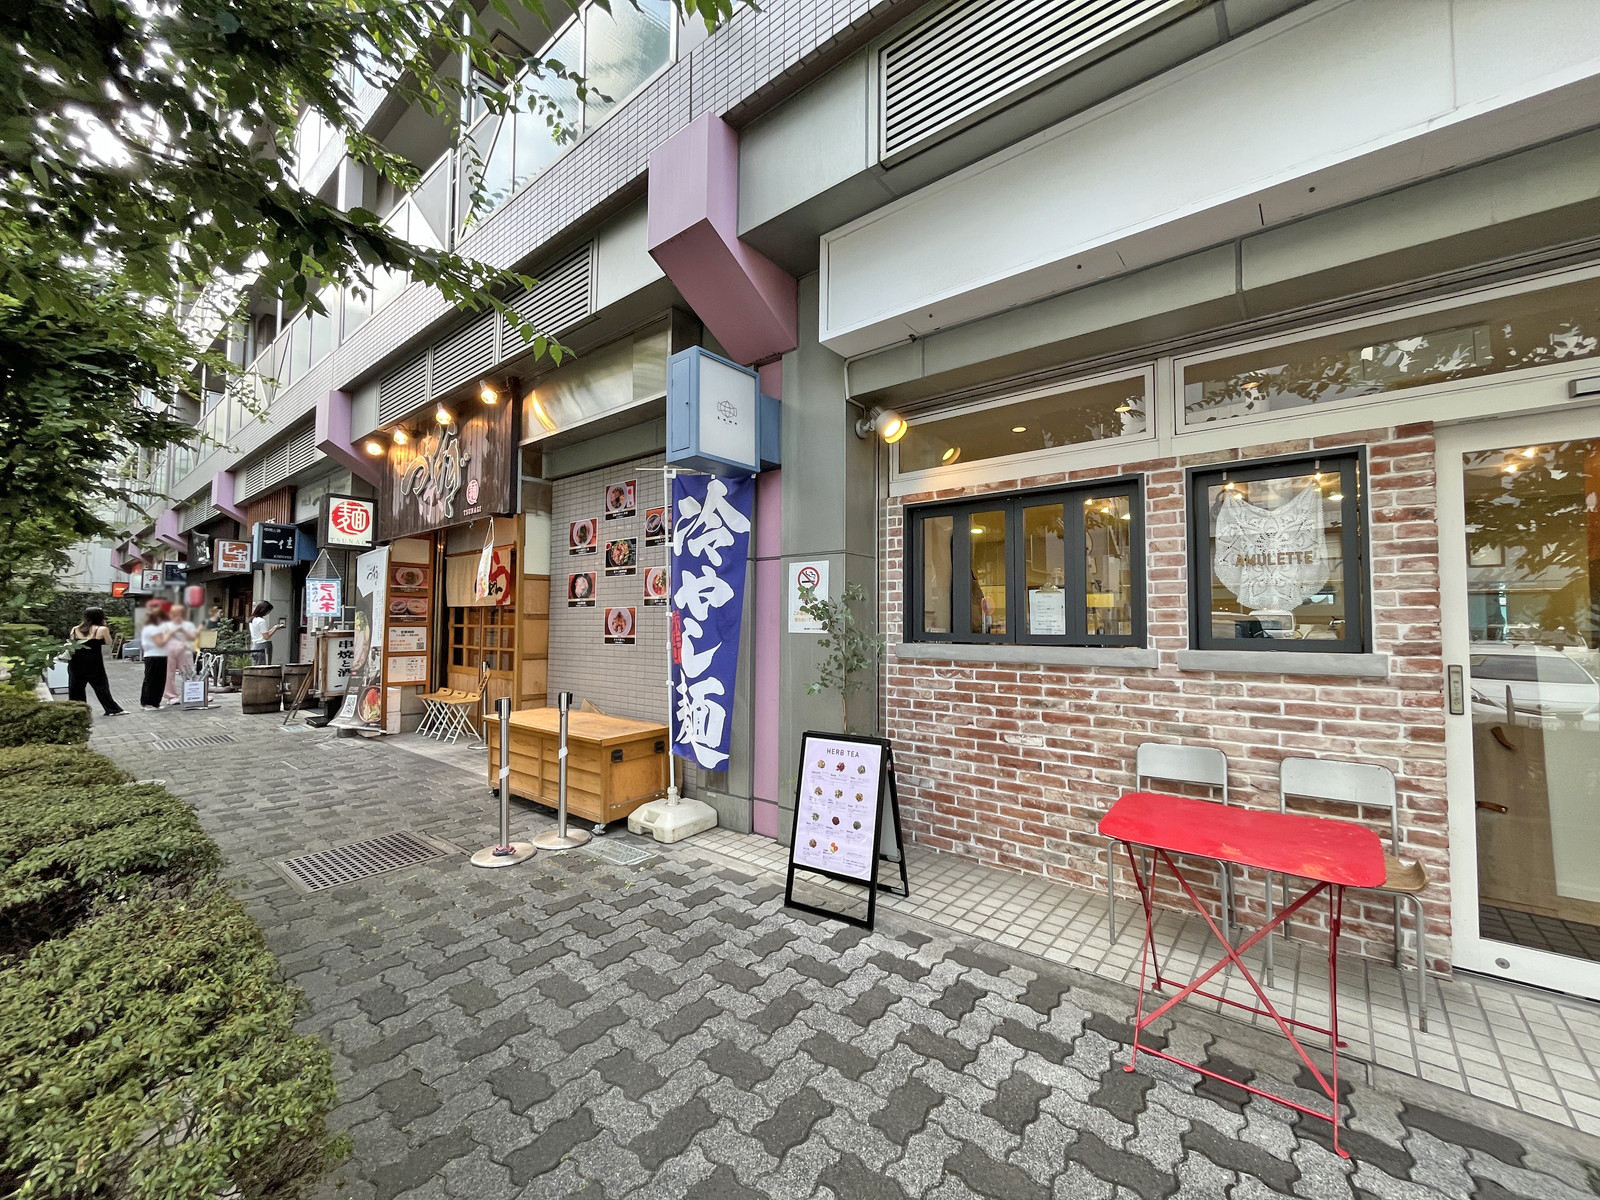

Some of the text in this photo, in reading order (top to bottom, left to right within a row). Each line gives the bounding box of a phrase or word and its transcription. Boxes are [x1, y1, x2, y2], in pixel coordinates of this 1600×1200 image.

[334, 500, 368, 535] 麺
[1235, 550, 1313, 567] AMULETTE
[673, 478, 751, 770] 冷やし麺
[826, 748, 860, 758] HERB TEA
